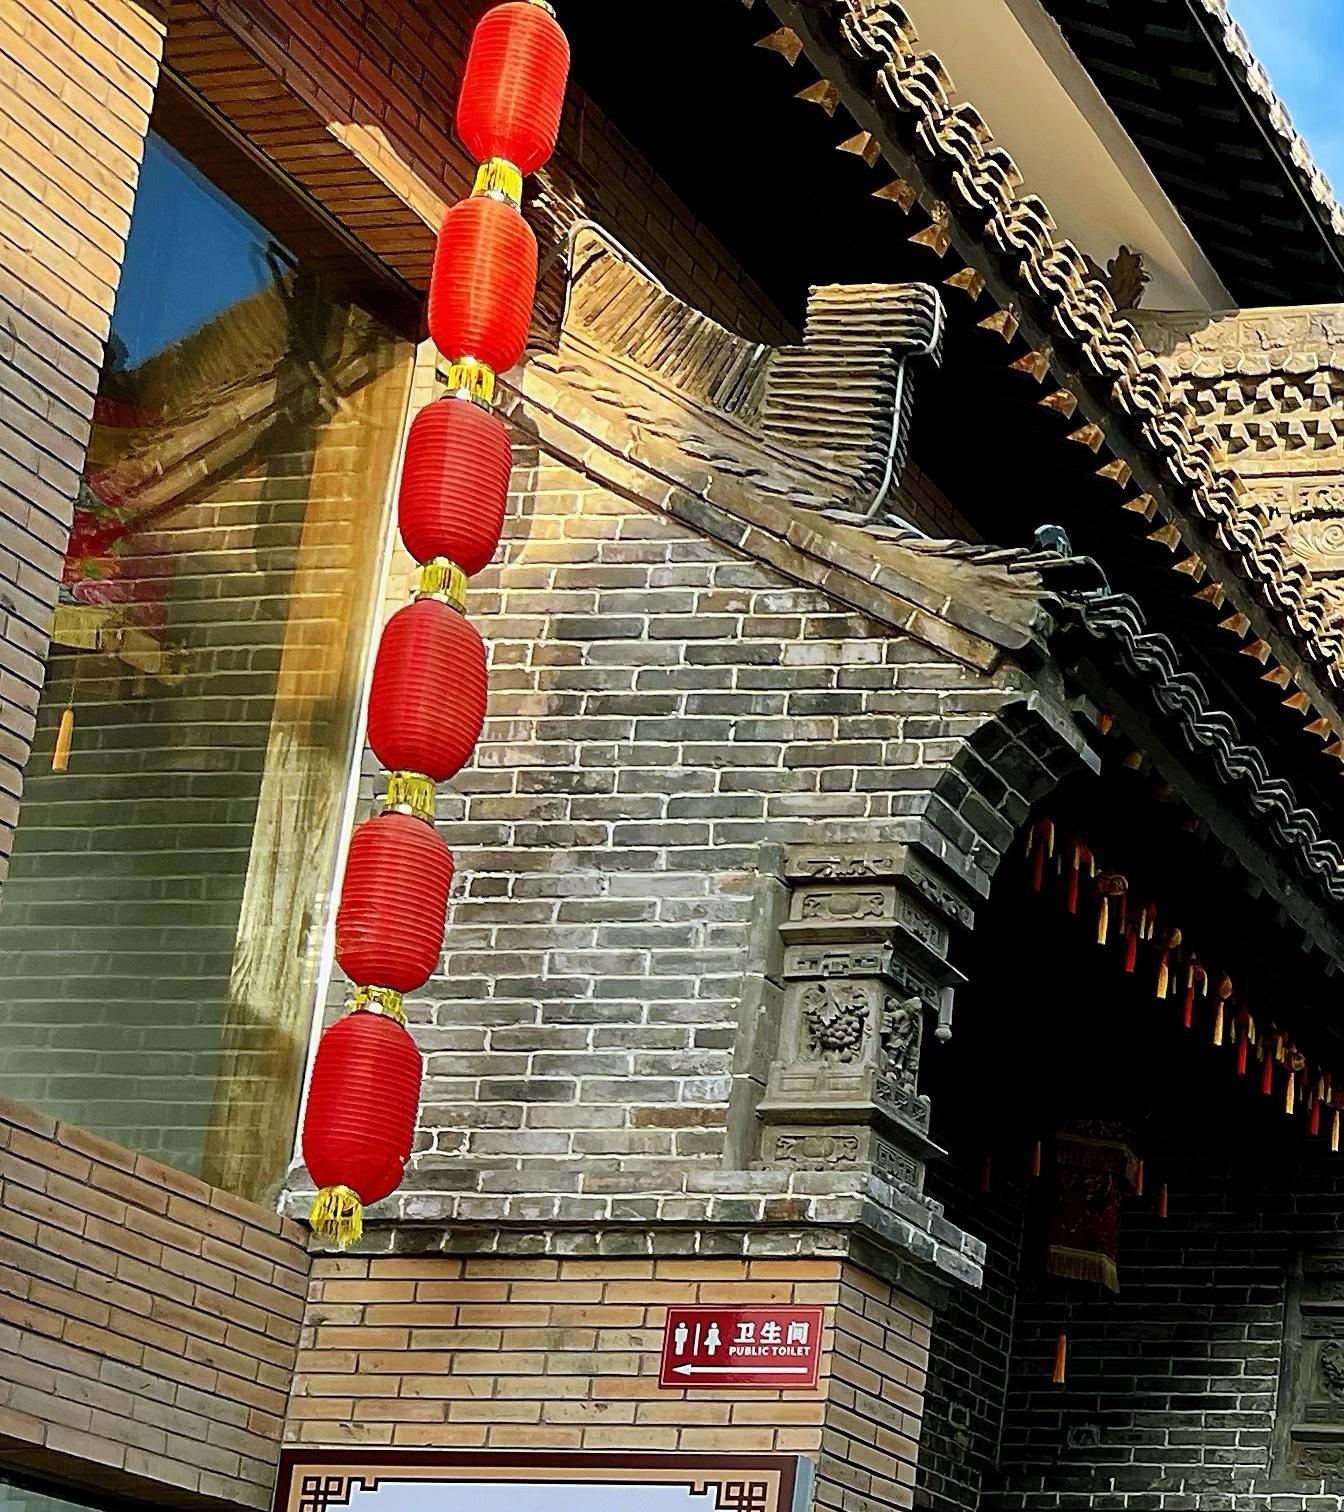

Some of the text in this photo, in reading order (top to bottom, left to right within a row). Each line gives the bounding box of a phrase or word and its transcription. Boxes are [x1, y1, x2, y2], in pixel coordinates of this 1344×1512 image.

[733, 1321, 810, 1345] 卫生间
[729, 1346, 811, 1356] PUBLIC TOILET
